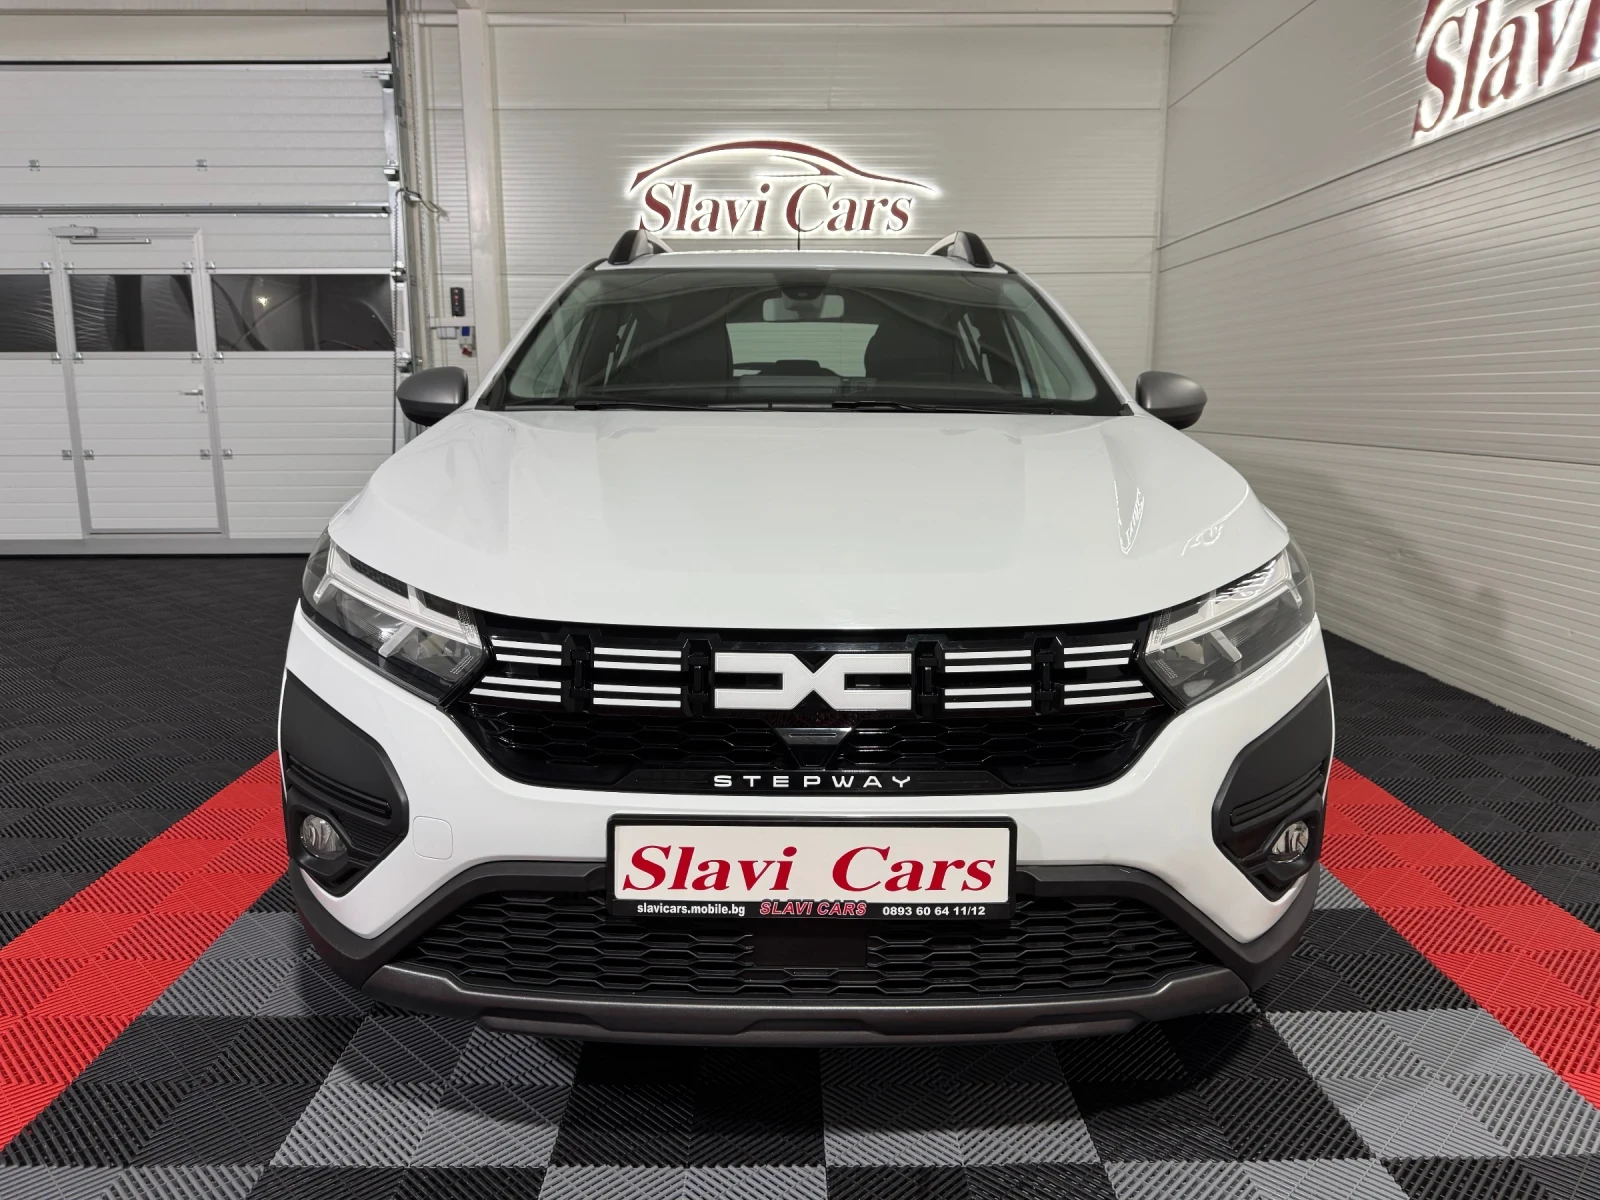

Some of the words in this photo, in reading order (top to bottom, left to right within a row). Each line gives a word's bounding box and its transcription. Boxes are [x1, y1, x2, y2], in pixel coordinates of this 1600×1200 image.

[638, 182, 771, 233] Slavi
[785, 182, 913, 233] Cars
[713, 775, 911, 788] STEPWAY
[622, 844, 798, 891] Slavi
[831, 845, 996, 892] Cars
[637, 902, 746, 917] slavicars.mobile.bg
[760, 900, 813, 915] SLAVI
[817, 901, 867, 916] CARS
[882, 906, 913, 916] 0893
[915, 906, 931, 916] 60
[934, 906, 950, 916] 64
[953, 906, 986, 916] 11/12
